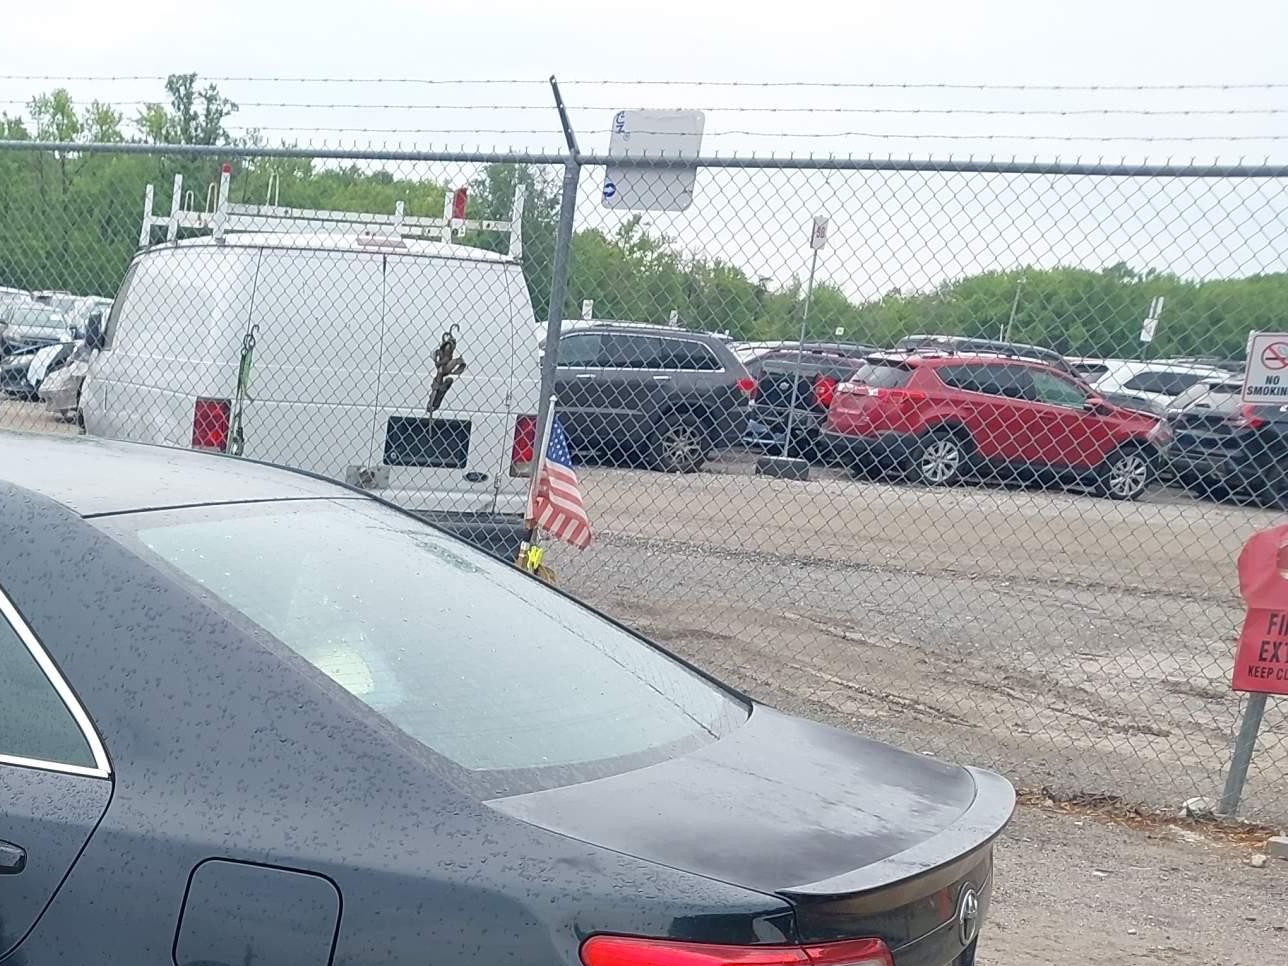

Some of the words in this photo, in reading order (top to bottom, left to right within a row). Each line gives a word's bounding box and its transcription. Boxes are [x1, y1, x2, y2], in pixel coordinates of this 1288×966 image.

[1265, 375, 1280, 385] NO
[1267, 612, 1288, 636] FI
[1248, 664, 1274, 678] KEEP
